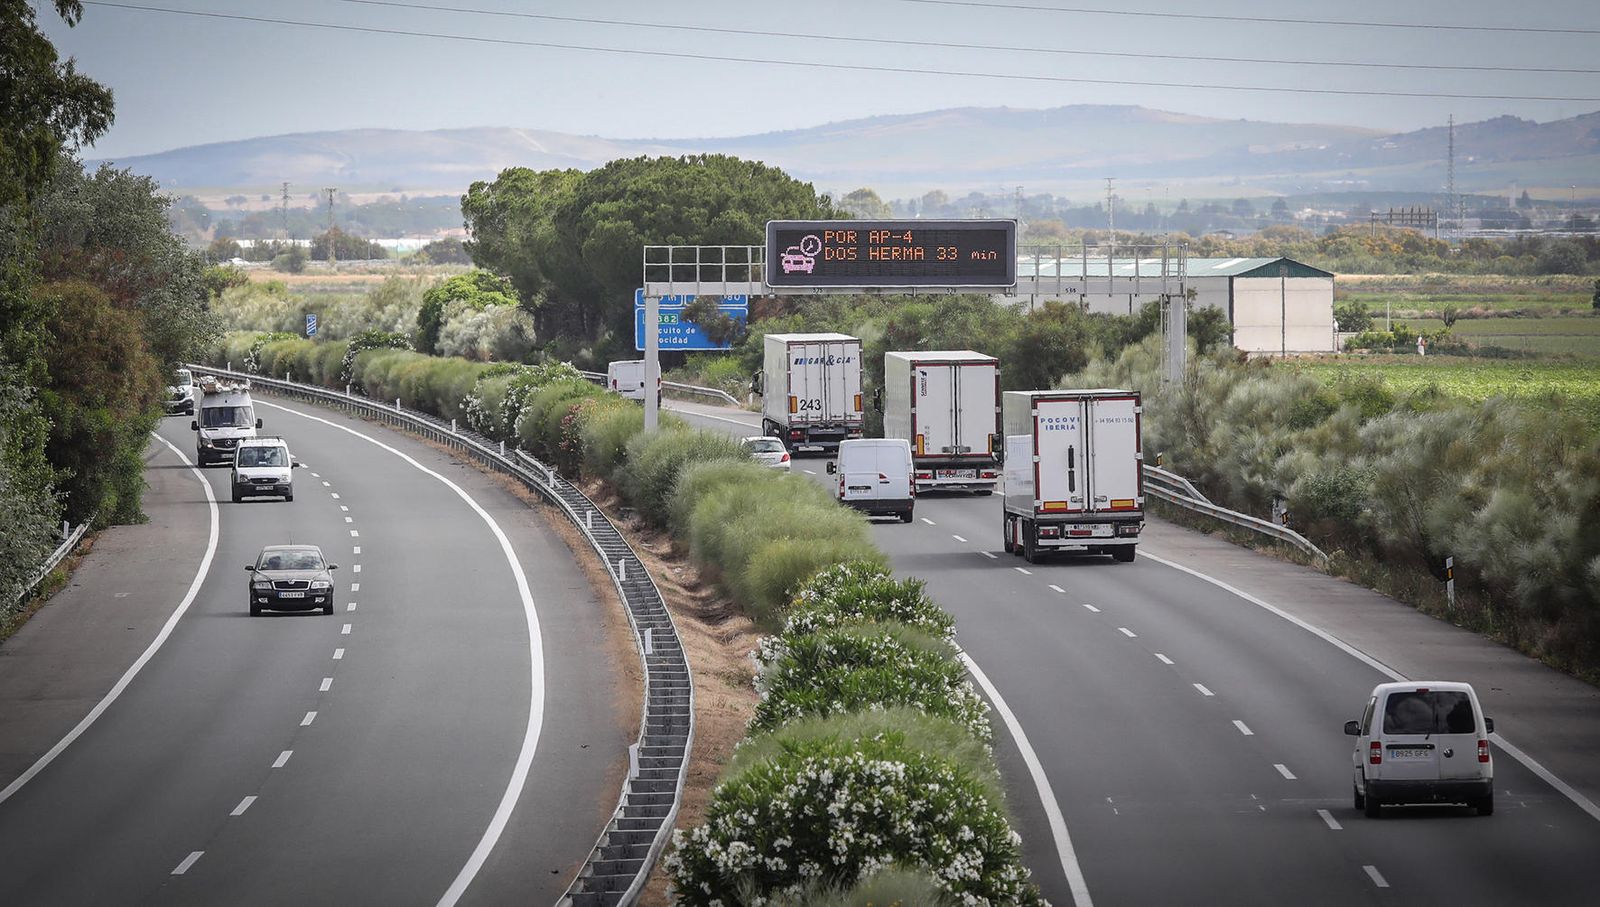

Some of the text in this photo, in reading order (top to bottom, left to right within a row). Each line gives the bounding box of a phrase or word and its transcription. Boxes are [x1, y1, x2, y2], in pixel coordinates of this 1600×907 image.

[824, 230, 913, 243] POR AP-4
[824, 247, 997, 260] DOS HERMA 33 min
[799, 399, 821, 411] 243
[1045, 423, 1076, 431] IBERIA
